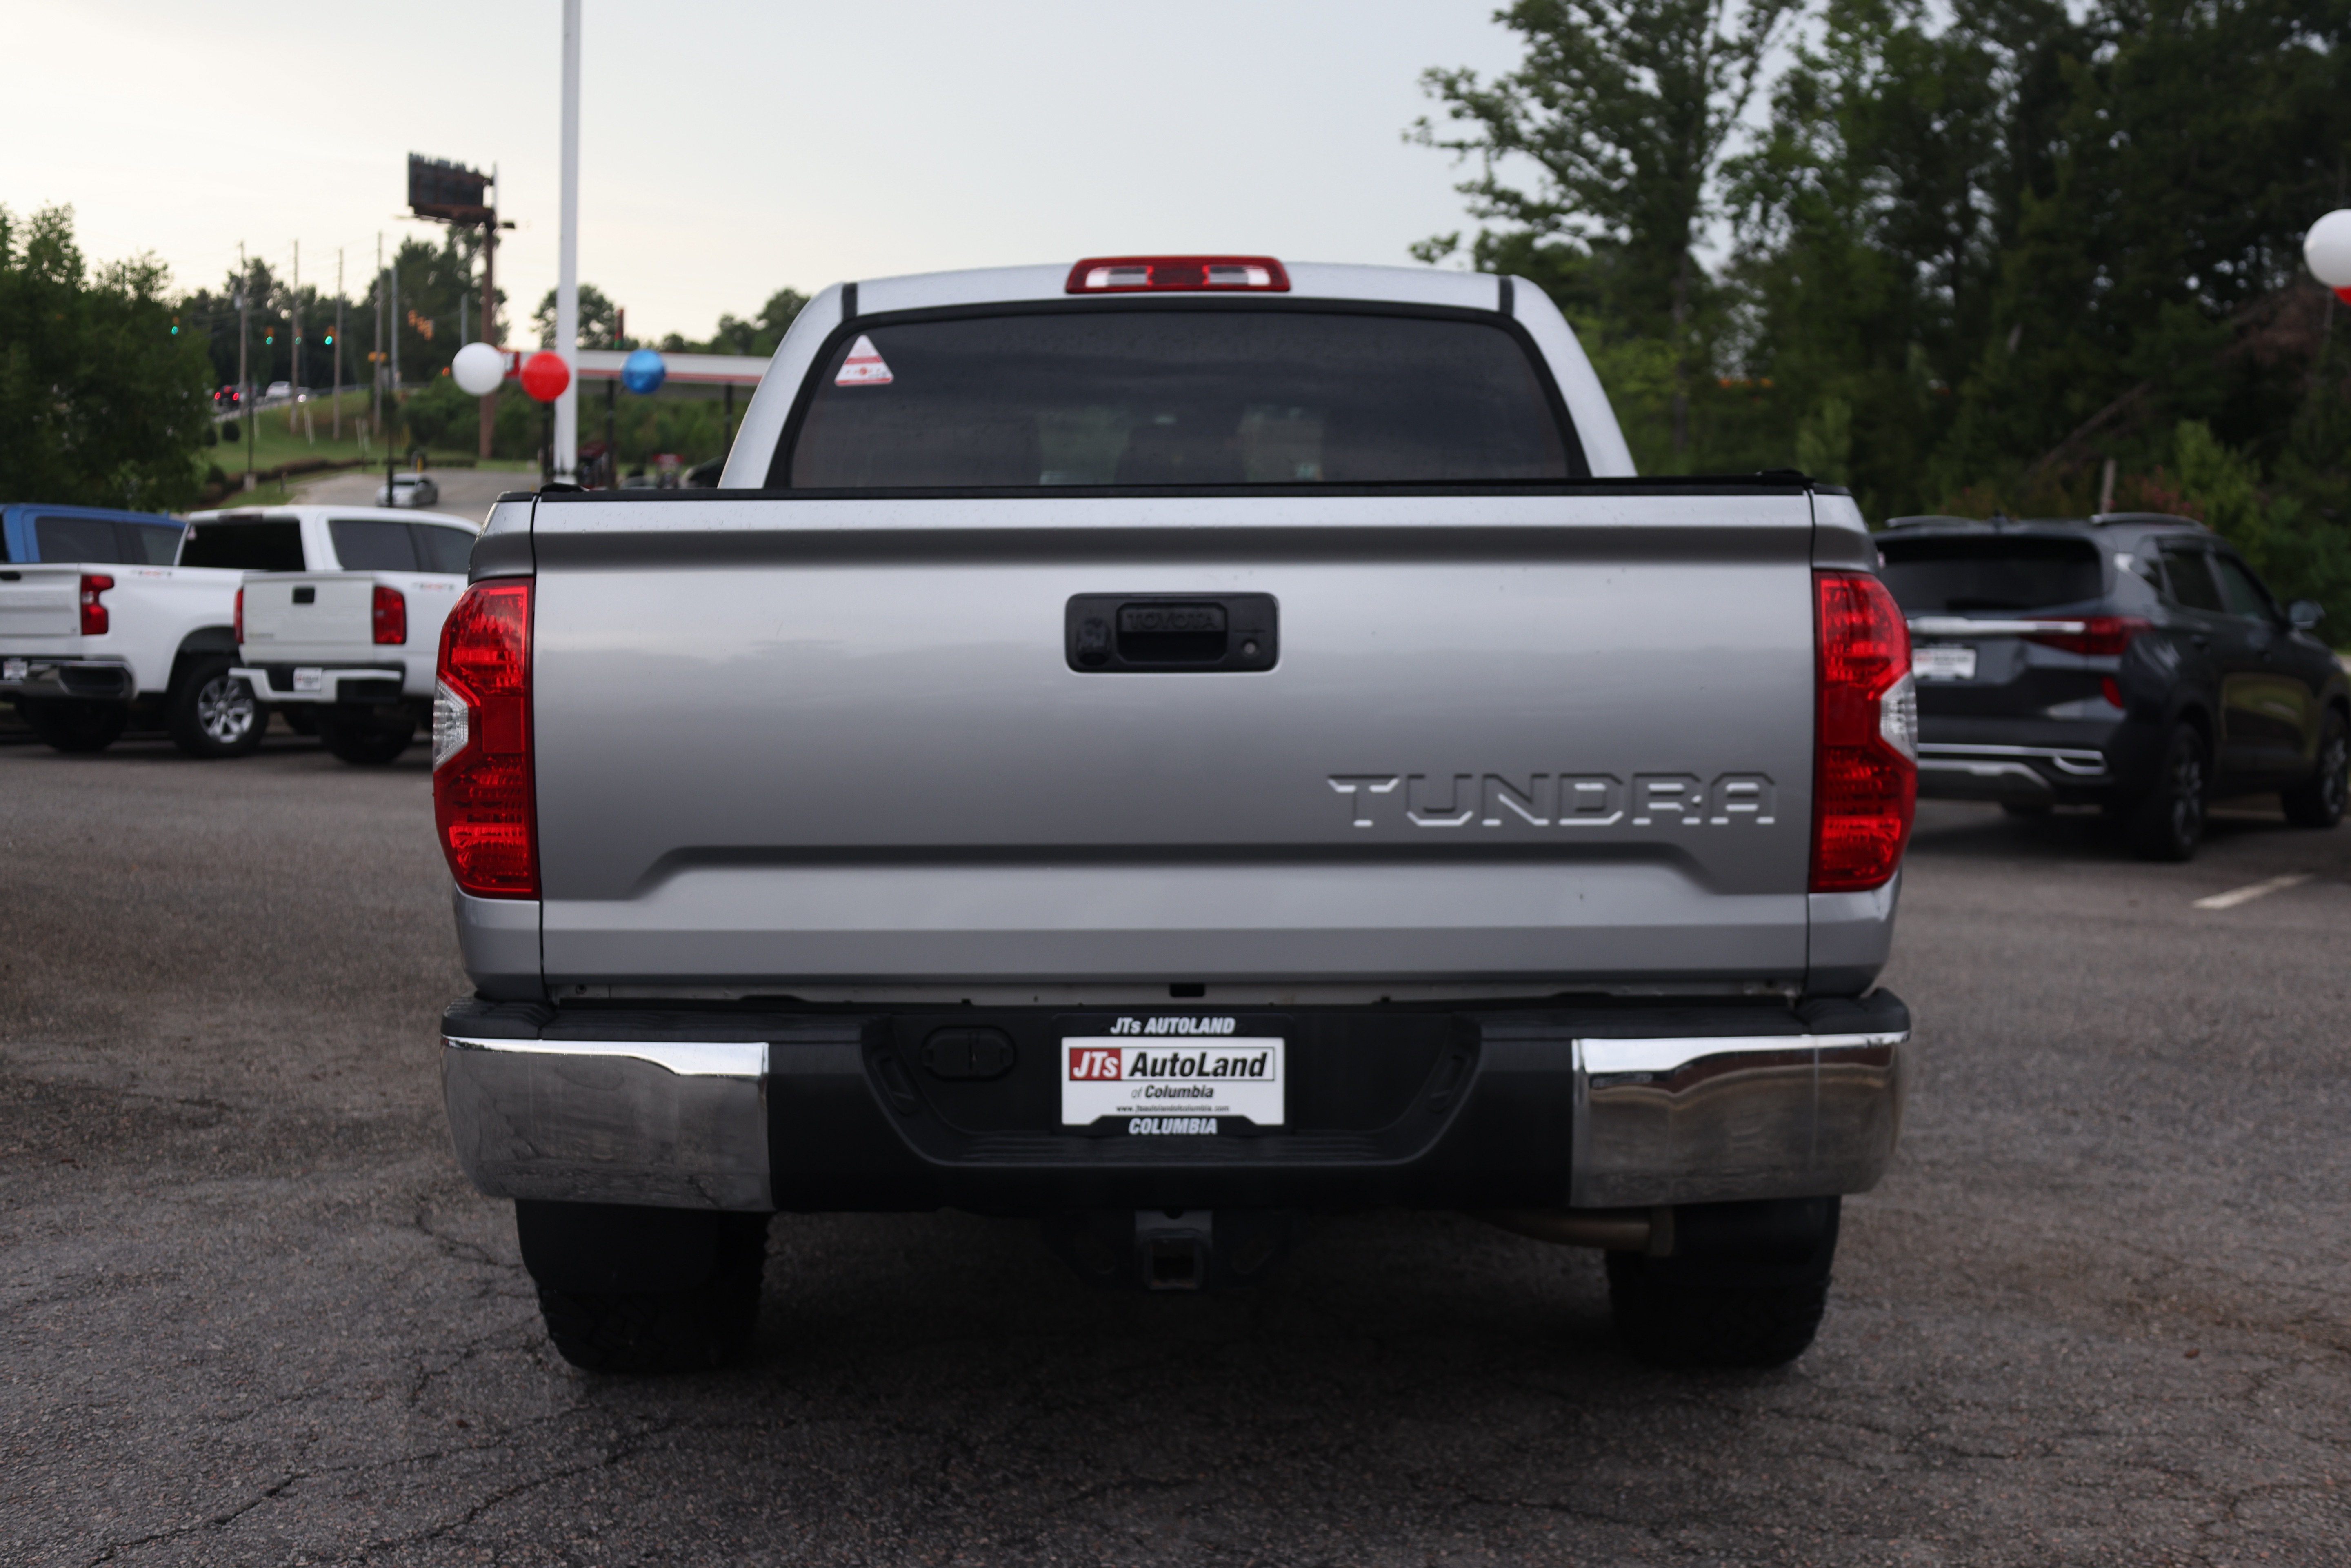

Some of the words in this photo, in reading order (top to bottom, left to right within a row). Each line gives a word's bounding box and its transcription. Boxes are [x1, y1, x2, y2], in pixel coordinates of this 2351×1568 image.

[1127, 613, 1218, 629] TOYOTA
[1327, 772, 1775, 827] TUNDRA
[1110, 1017, 1141, 1034] JTs
[1144, 1017, 1236, 1034] AUTOLAND
[1073, 1051, 1120, 1079] JTs
[1129, 1052, 1267, 1077] AutoLand
[1131, 1086, 1143, 1099] of
[1145, 1085, 1214, 1098] Columbia
[1129, 1119, 1218, 1134] COLUMBIA
